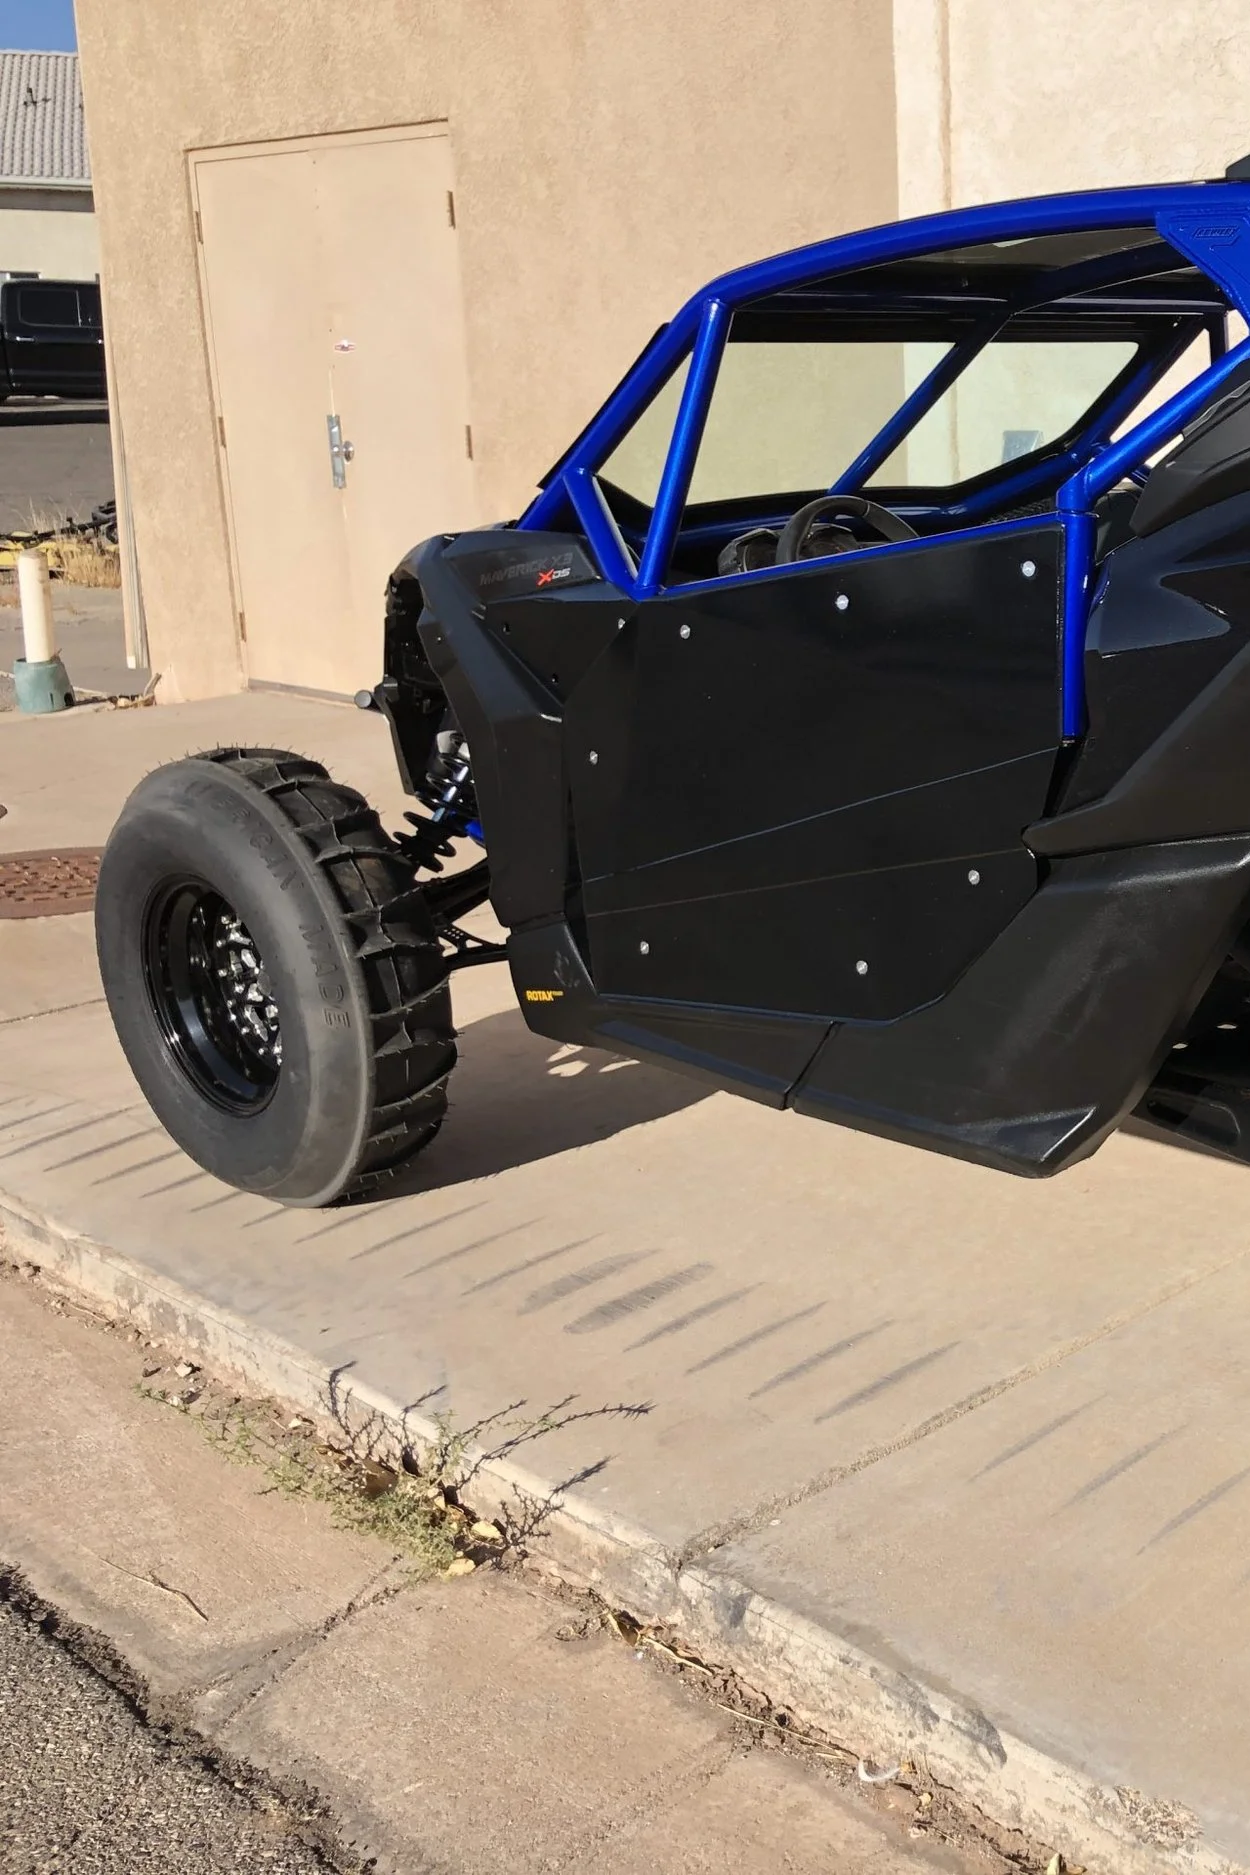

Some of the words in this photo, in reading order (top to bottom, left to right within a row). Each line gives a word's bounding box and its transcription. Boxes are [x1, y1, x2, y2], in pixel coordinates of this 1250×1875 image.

[481, 558, 549, 585] MAVERICK
[550, 552, 574, 568] X3
[526, 990, 554, 1001] ROTAX
